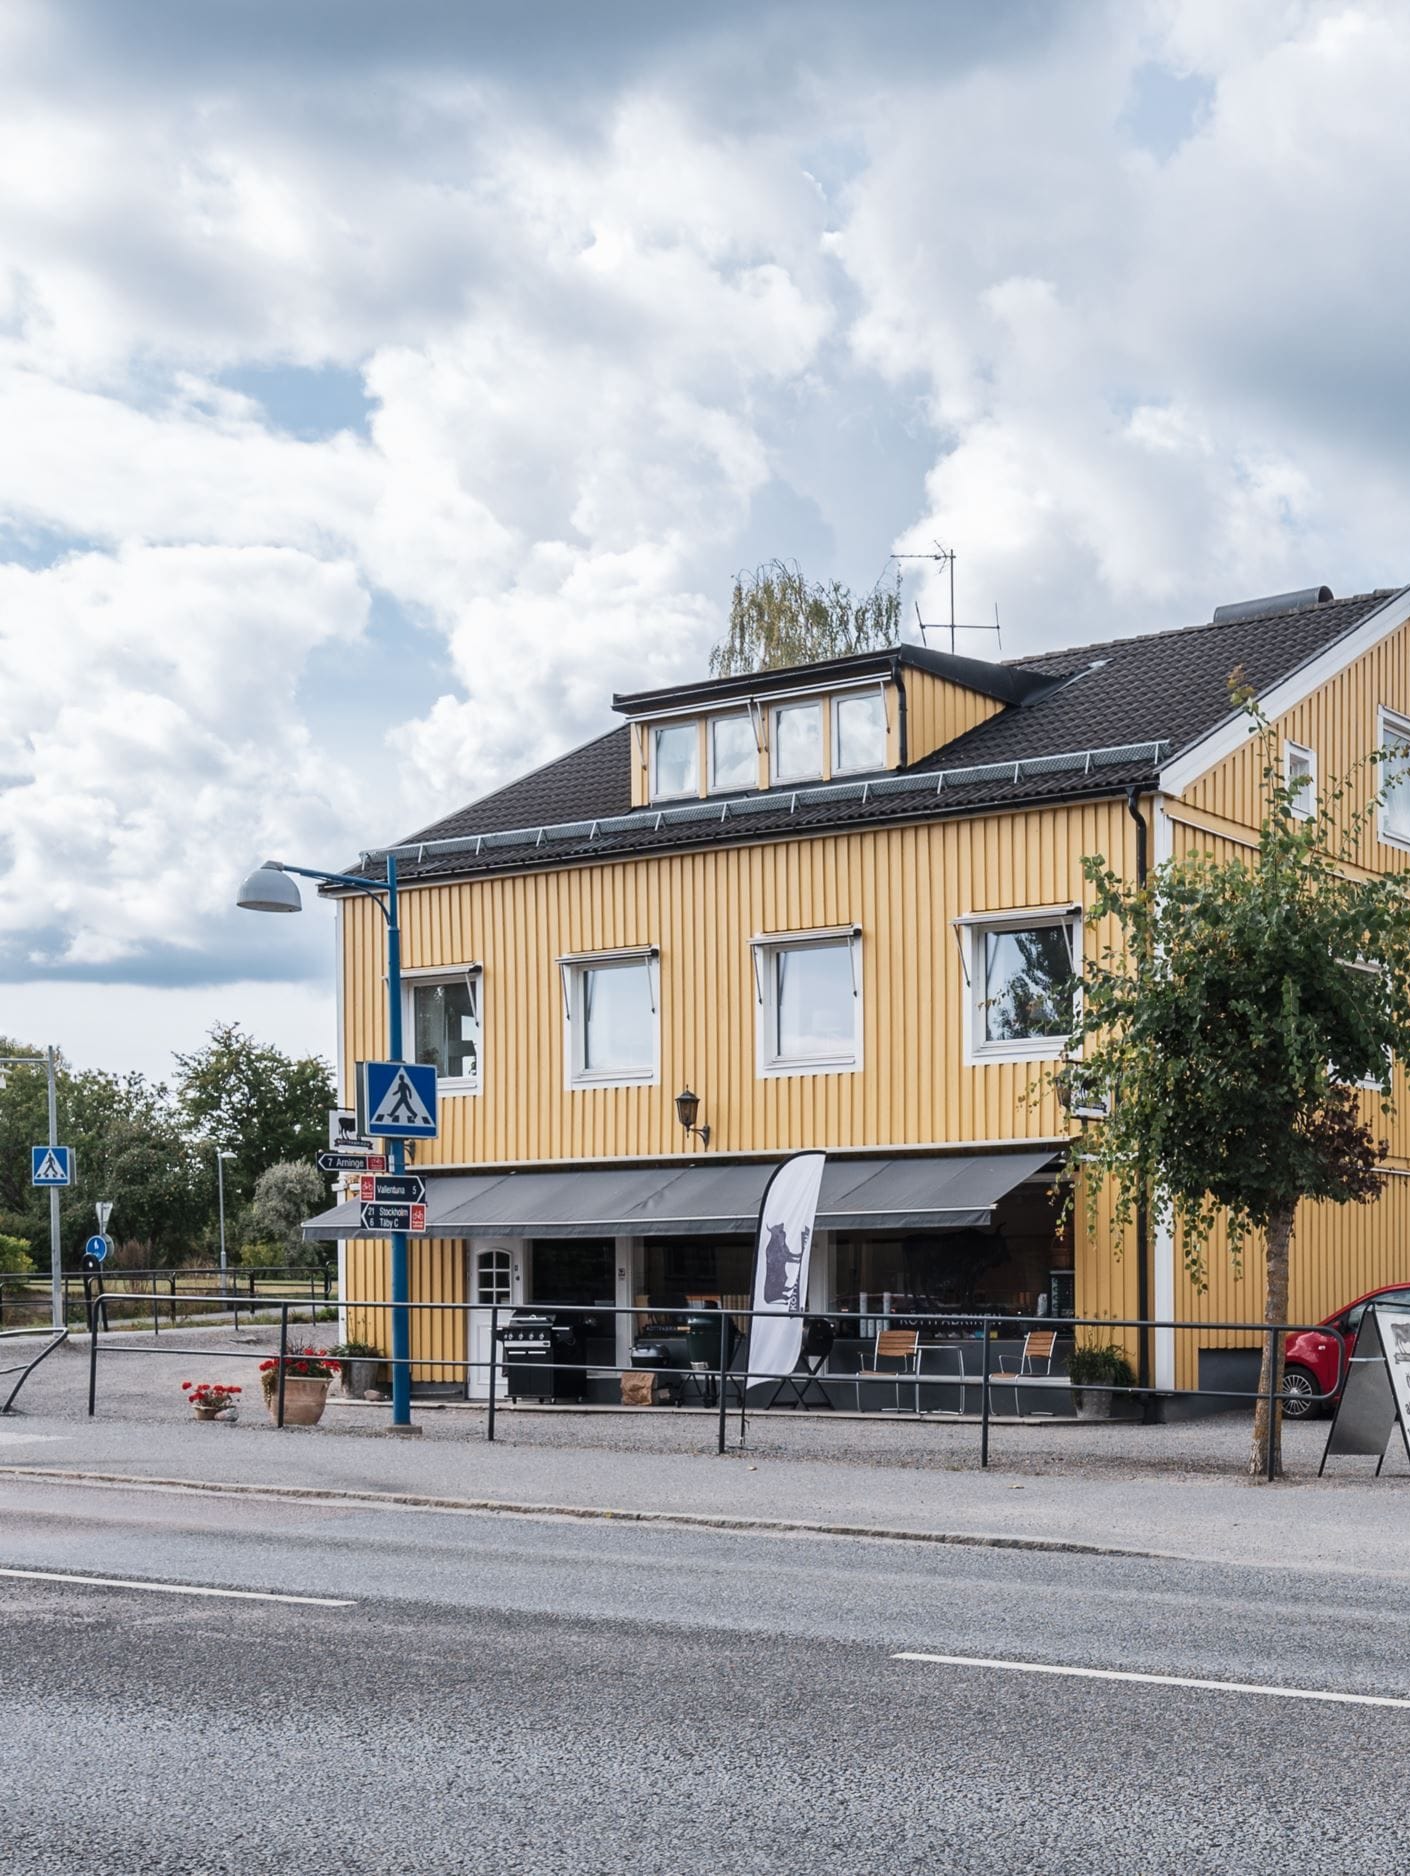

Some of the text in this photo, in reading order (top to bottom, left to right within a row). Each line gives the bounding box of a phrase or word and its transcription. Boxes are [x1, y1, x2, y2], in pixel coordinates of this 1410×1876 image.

[328, 1158, 333, 1167] 7
[336, 1157, 365, 1168] Arninge
[376, 1184, 405, 1195] Vallentuna
[412, 1185, 417, 1195] 5
[368, 1207, 409, 1217] 21 Stockholm
[379, 1217, 393, 1229] Täby
[394, 1218, 399, 1227] C
